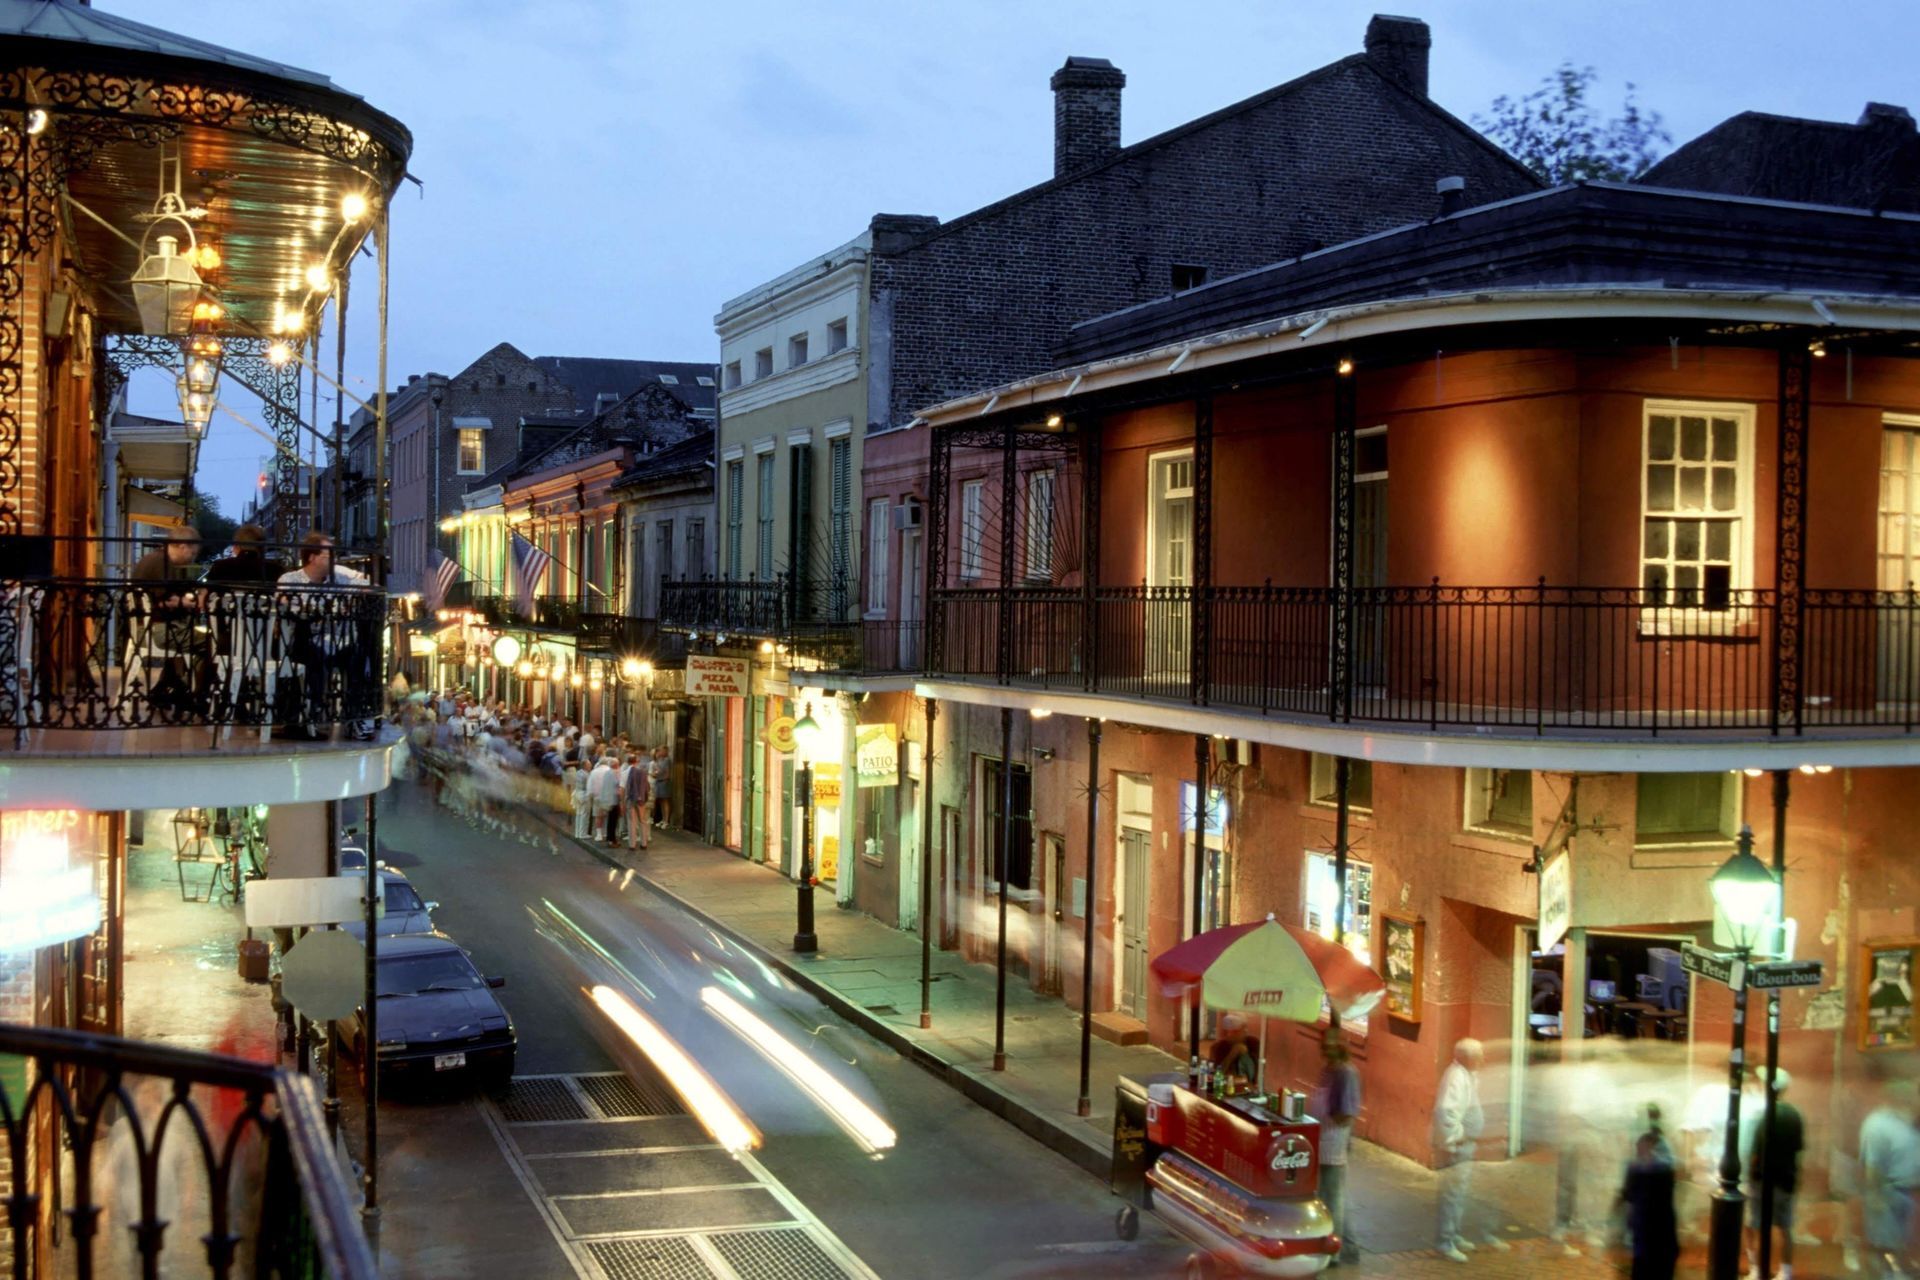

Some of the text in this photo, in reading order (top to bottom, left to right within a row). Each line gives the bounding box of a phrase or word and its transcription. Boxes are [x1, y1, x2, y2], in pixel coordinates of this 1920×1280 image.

[702, 674, 734, 684] PIZZA
[708, 683, 740, 694] PASTA
[863, 756, 893, 768] PATIO
[1702, 959, 1729, 981] Peter
